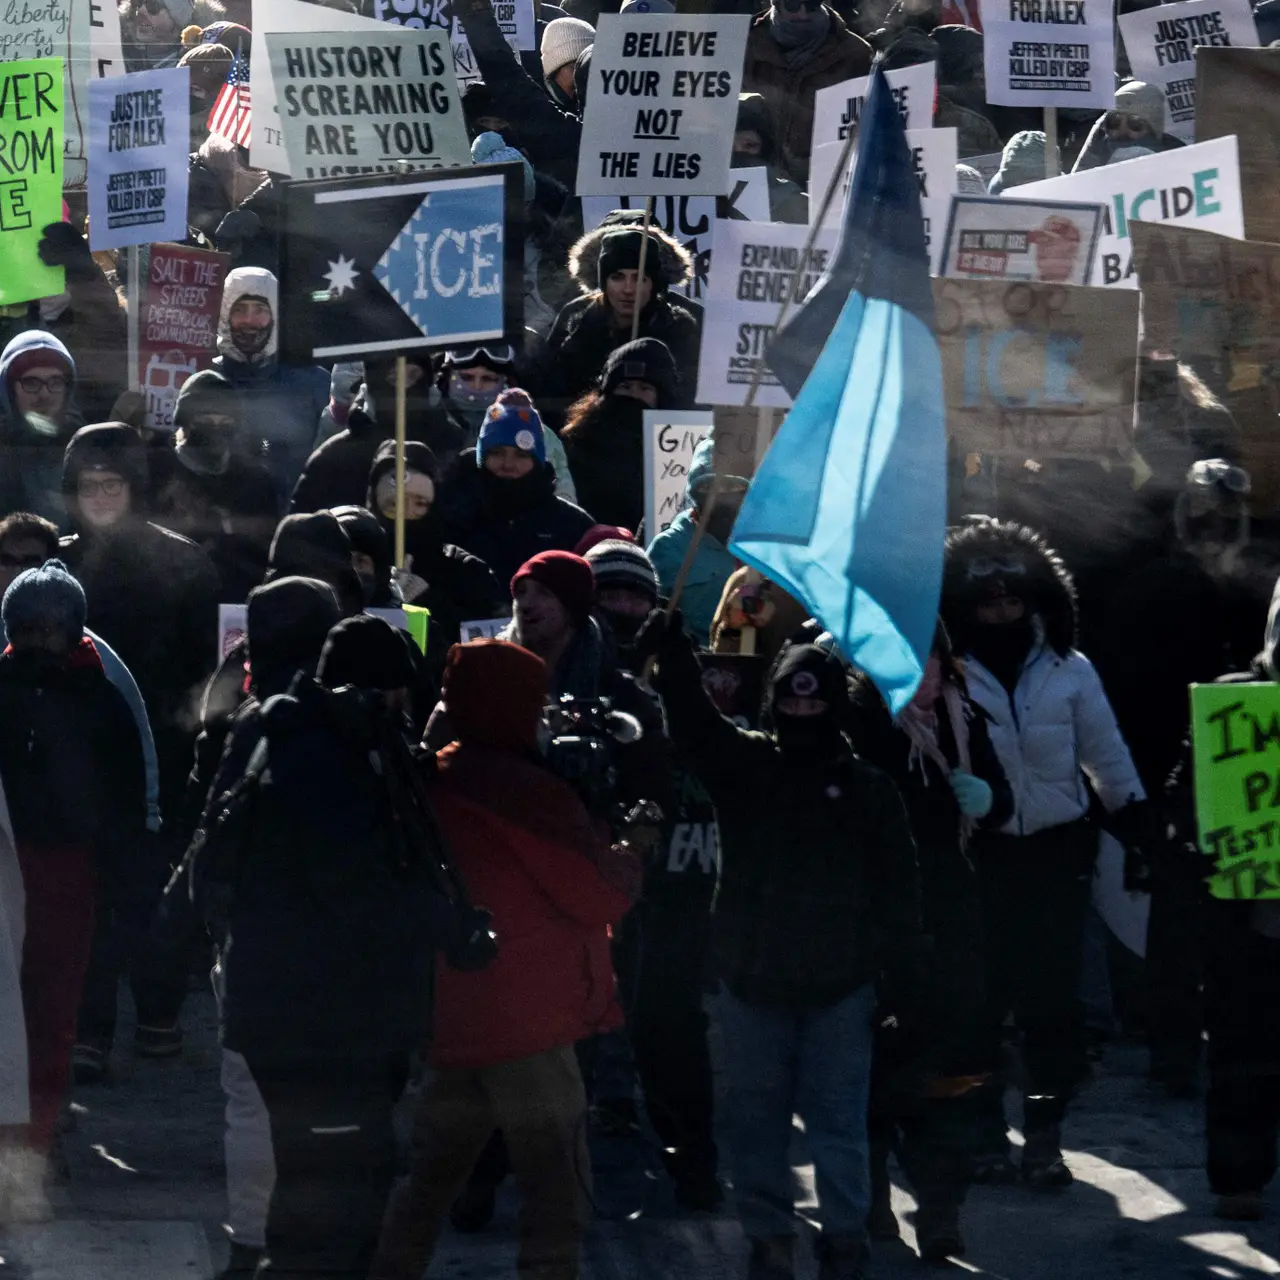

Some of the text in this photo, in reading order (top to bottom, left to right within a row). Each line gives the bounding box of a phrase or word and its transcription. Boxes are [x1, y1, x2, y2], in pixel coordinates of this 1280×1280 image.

[1045, 0, 1085, 24] ALEX
[622, 31, 717, 57] BELIEVE
[1008, 41, 1089, 59] JEFFREY PRETTI
[285, 43, 446, 78] HISTORY IS
[1009, 59, 1090, 77] KILLED BY CBP
[600, 69, 731, 98] YOUR EYES
[285, 80, 449, 116] SCREAMING
[636, 108, 682, 136] NOT
[304, 121, 435, 155] ARE YOU
[599, 151, 700, 179] THE LIES
[414, 222, 502, 299] ICE
